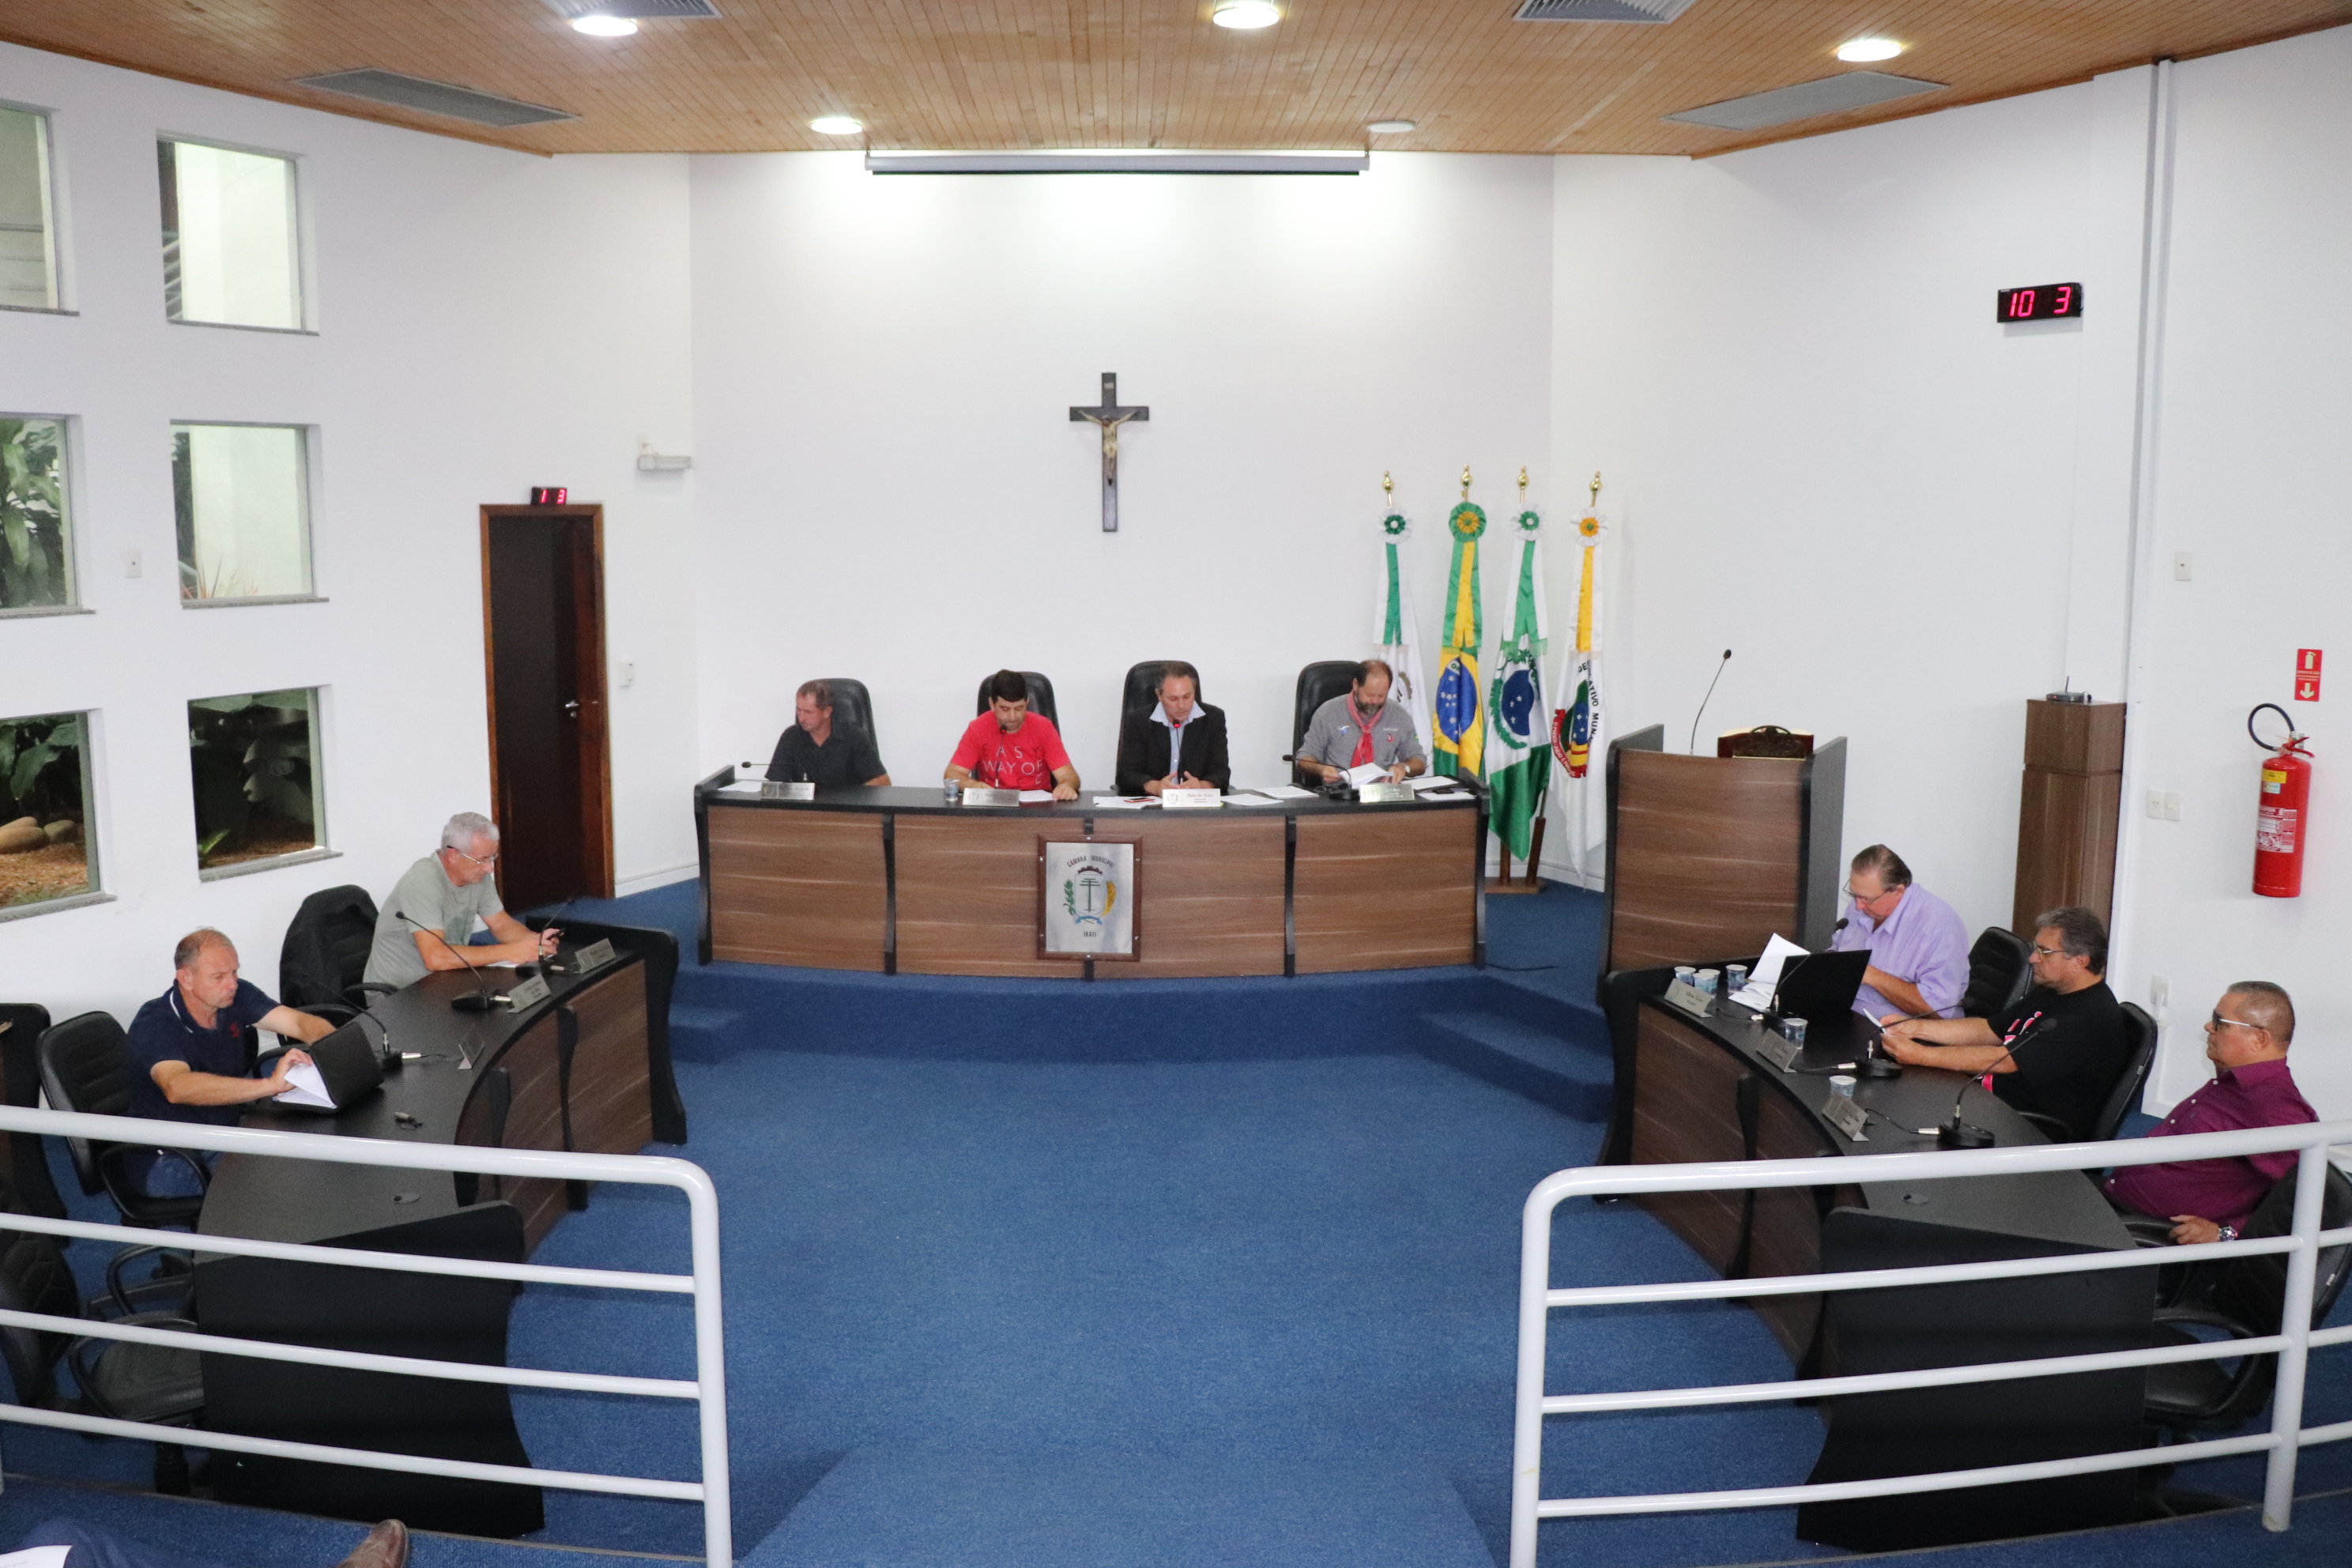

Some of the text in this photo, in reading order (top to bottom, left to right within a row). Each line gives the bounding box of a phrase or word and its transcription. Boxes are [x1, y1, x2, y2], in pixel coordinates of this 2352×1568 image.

[2009, 286, 2071, 317] 10 3
[540, 488, 567, 504] 1 3
[982, 760, 1042, 775] WAY OF
[1091, 855, 1115, 868] MUNICIPAL
